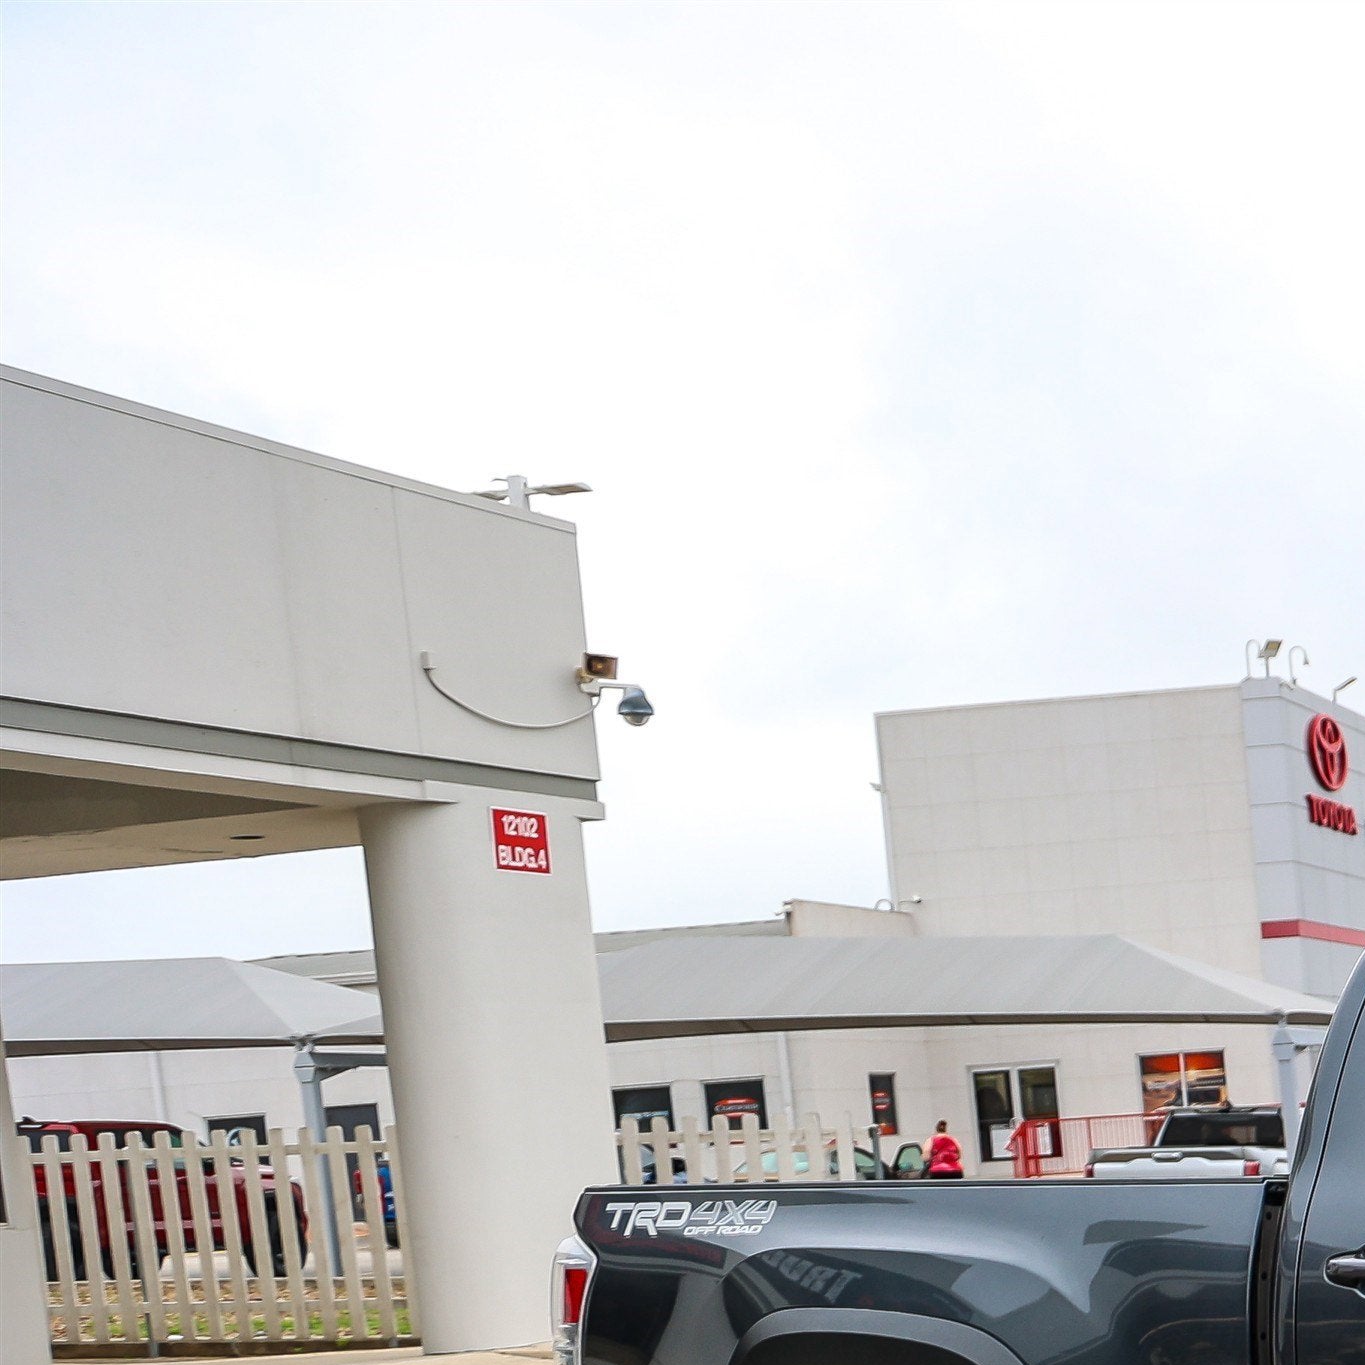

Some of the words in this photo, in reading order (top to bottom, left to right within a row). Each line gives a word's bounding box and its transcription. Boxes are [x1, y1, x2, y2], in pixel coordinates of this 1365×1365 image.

[605, 1201, 692, 1238] TRD
[683, 1225, 716, 1236] OFF
[716, 1225, 764, 1236] ROAD
